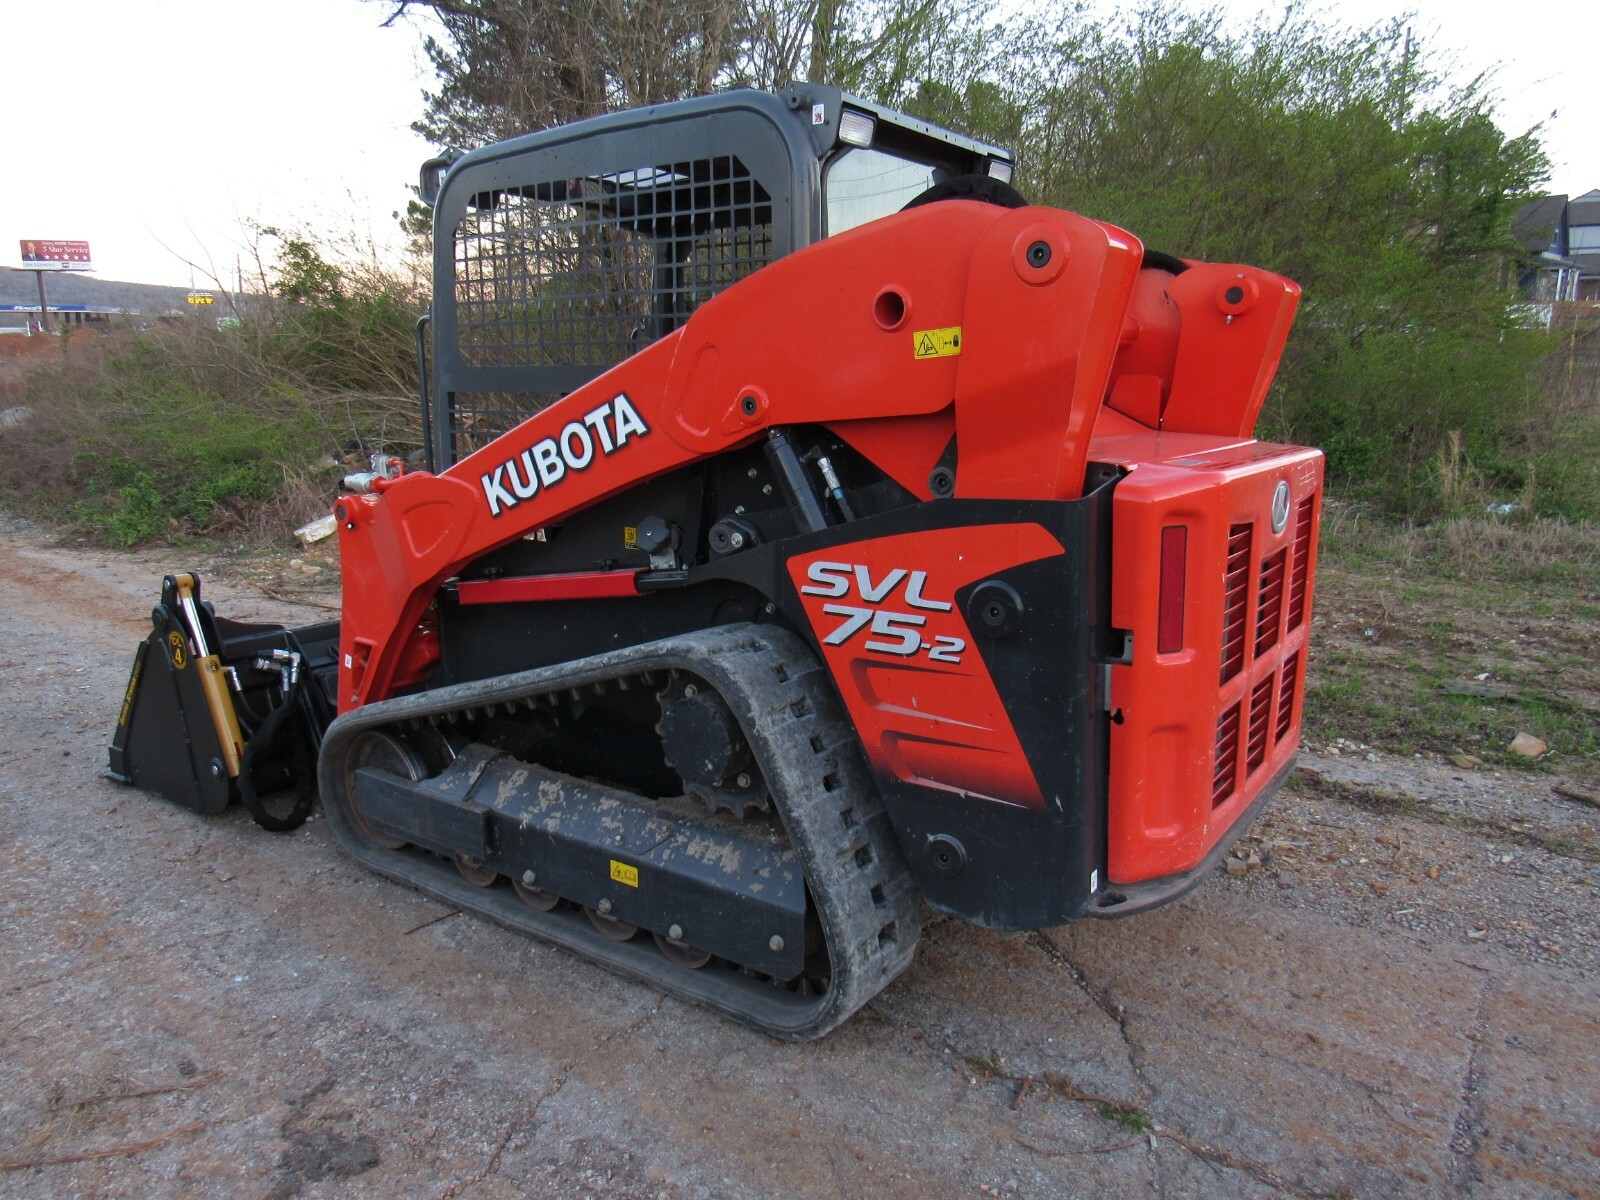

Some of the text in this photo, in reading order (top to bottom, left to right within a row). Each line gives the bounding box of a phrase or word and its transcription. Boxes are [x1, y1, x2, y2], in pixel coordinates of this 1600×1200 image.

[481, 393, 650, 517] KUBOTA
[800, 560, 952, 613] SVL
[175, 648, 182, 664] 4
[821, 603, 966, 664] 75-2
